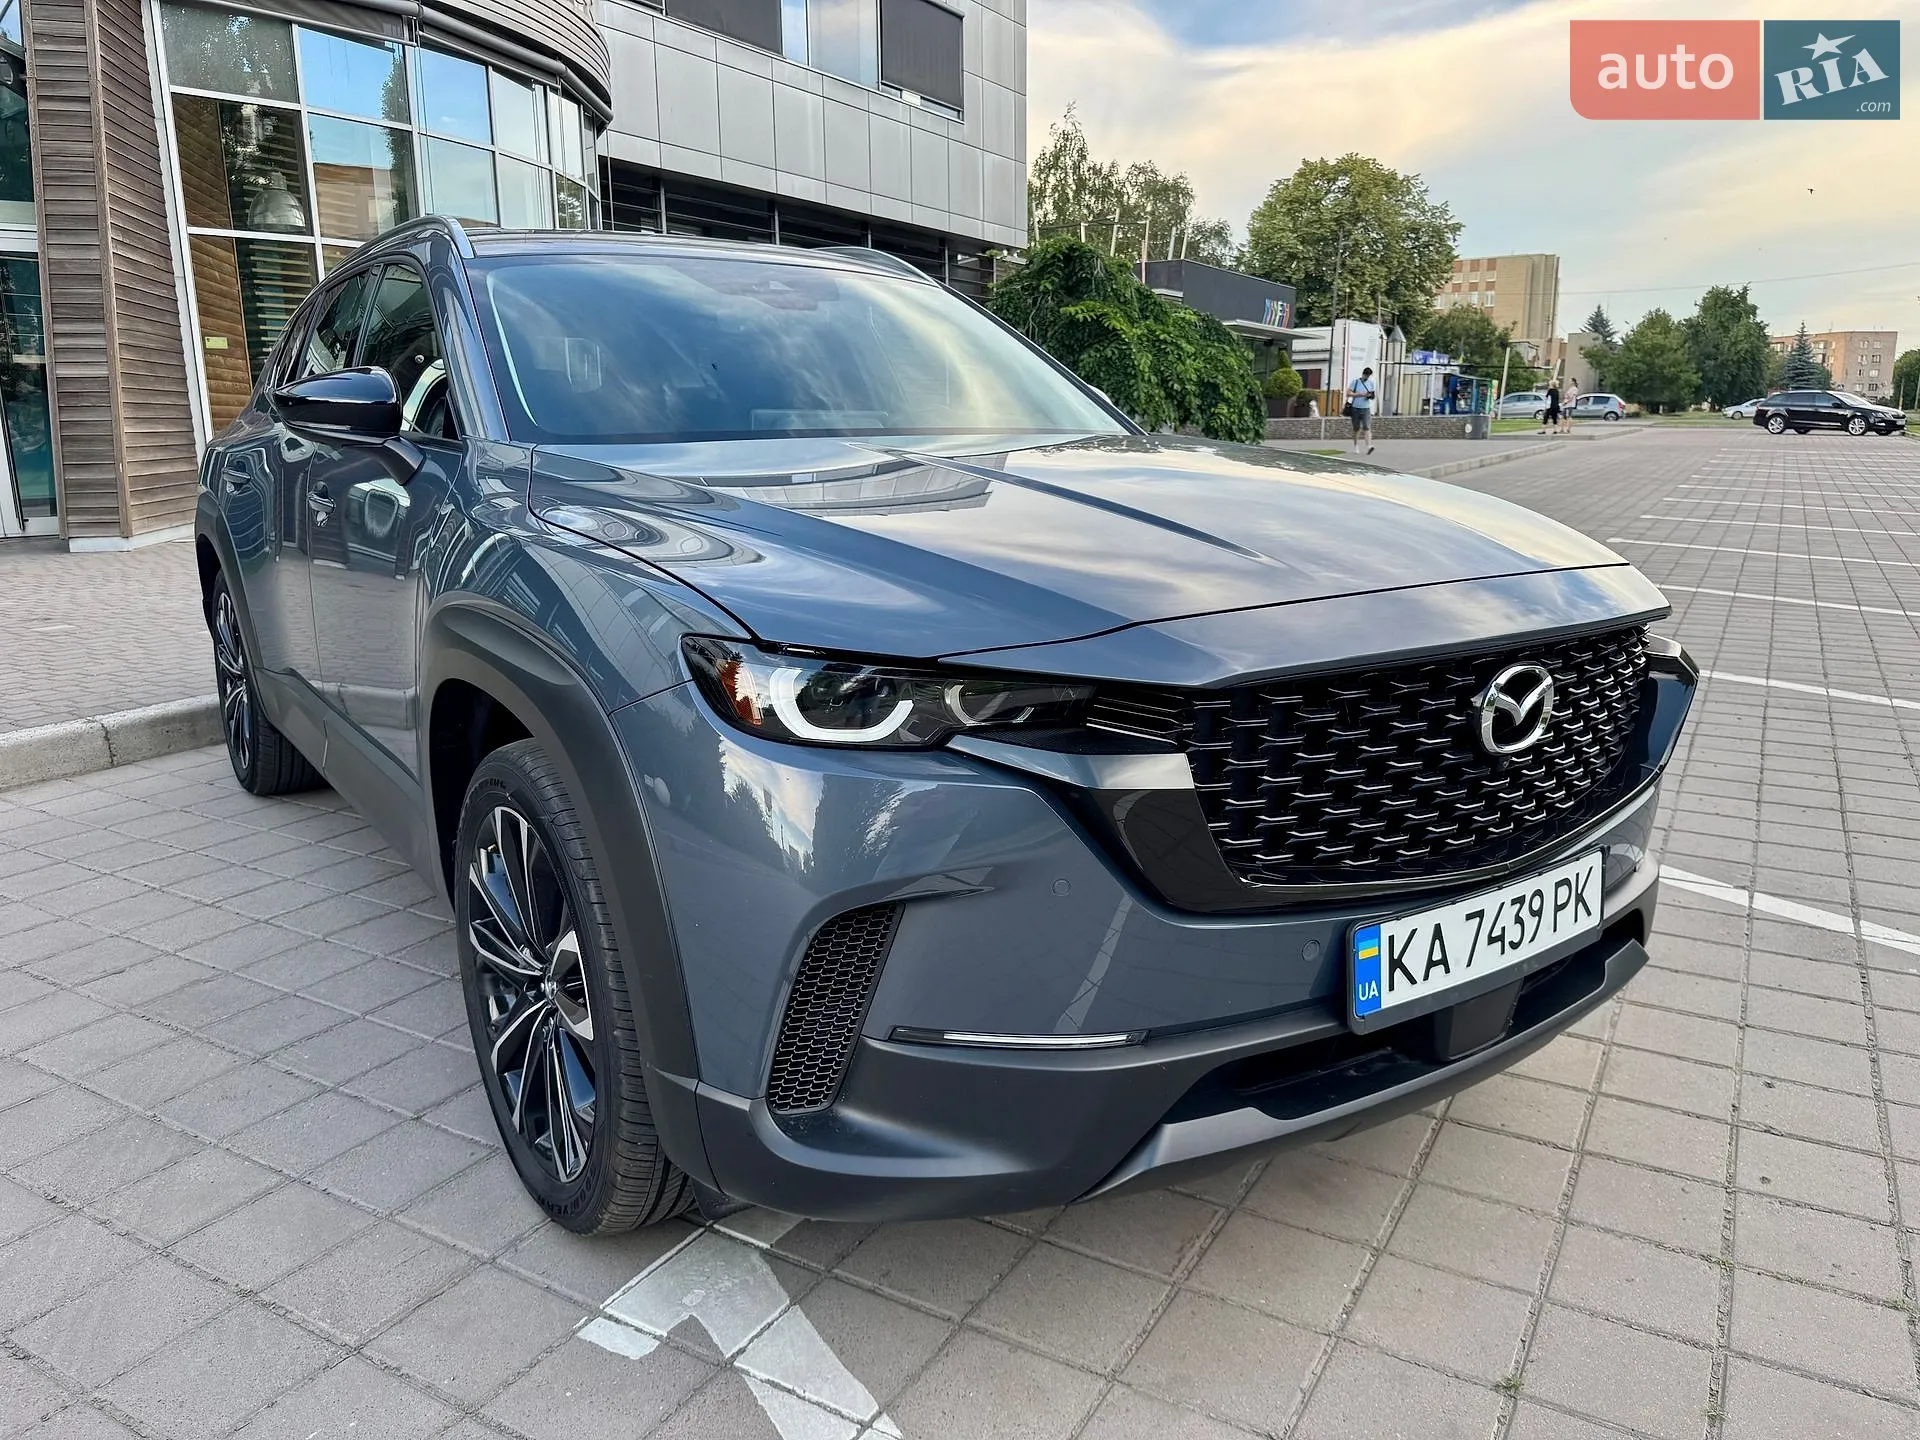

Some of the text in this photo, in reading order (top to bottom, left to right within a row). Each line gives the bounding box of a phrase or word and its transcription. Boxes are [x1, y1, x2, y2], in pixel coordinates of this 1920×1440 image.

[1388, 865, 1593, 992] KA 7439 PK
[1359, 980, 1379, 1001] UA
